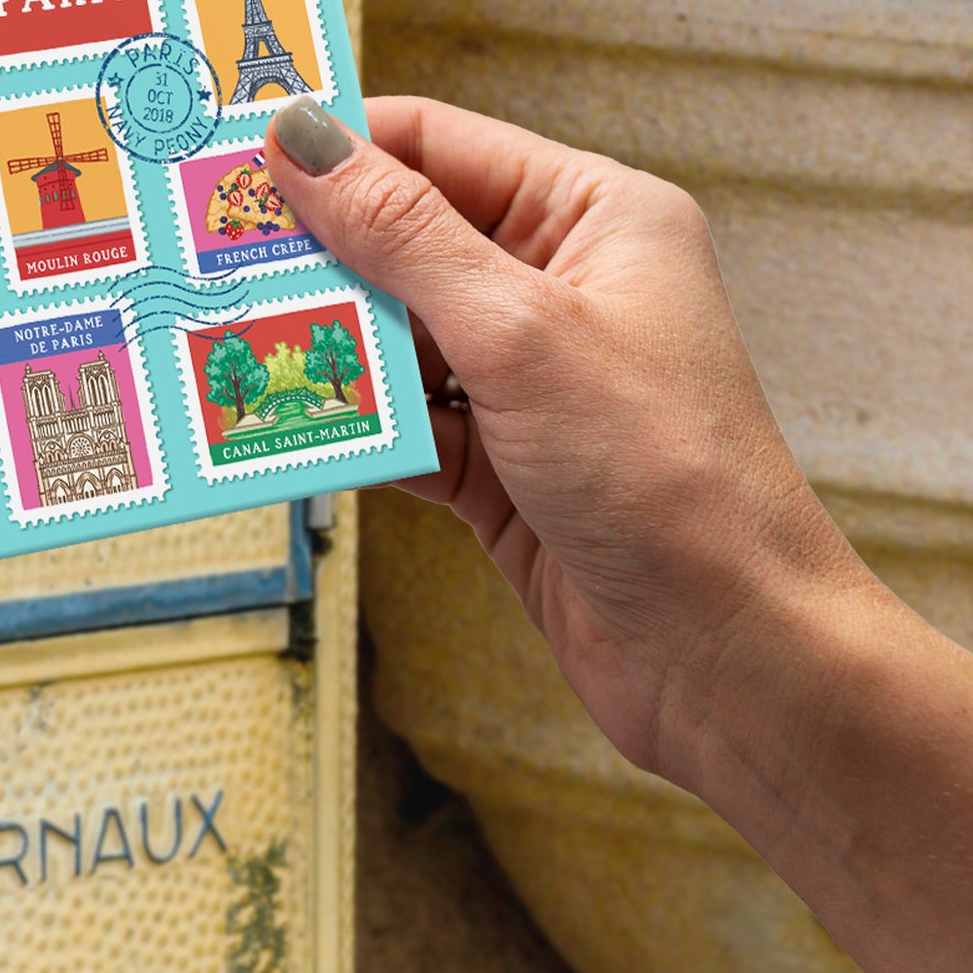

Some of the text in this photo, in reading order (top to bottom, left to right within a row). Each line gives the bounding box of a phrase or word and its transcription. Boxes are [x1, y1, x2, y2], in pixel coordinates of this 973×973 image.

[125, 43, 200, 75] PARIS
[147, 88, 174, 105] OCT
[143, 107, 174, 123] 2018
[26, 246, 128, 274] MOULIN ROUGE
[216, 238, 312, 266] FRENCH CRÊPE
[14, 316, 104, 343] NOTRE-DAME
[30, 333, 93, 355] DE PARIS
[222, 420, 370, 460] CANAL SAINT-MARTIN
